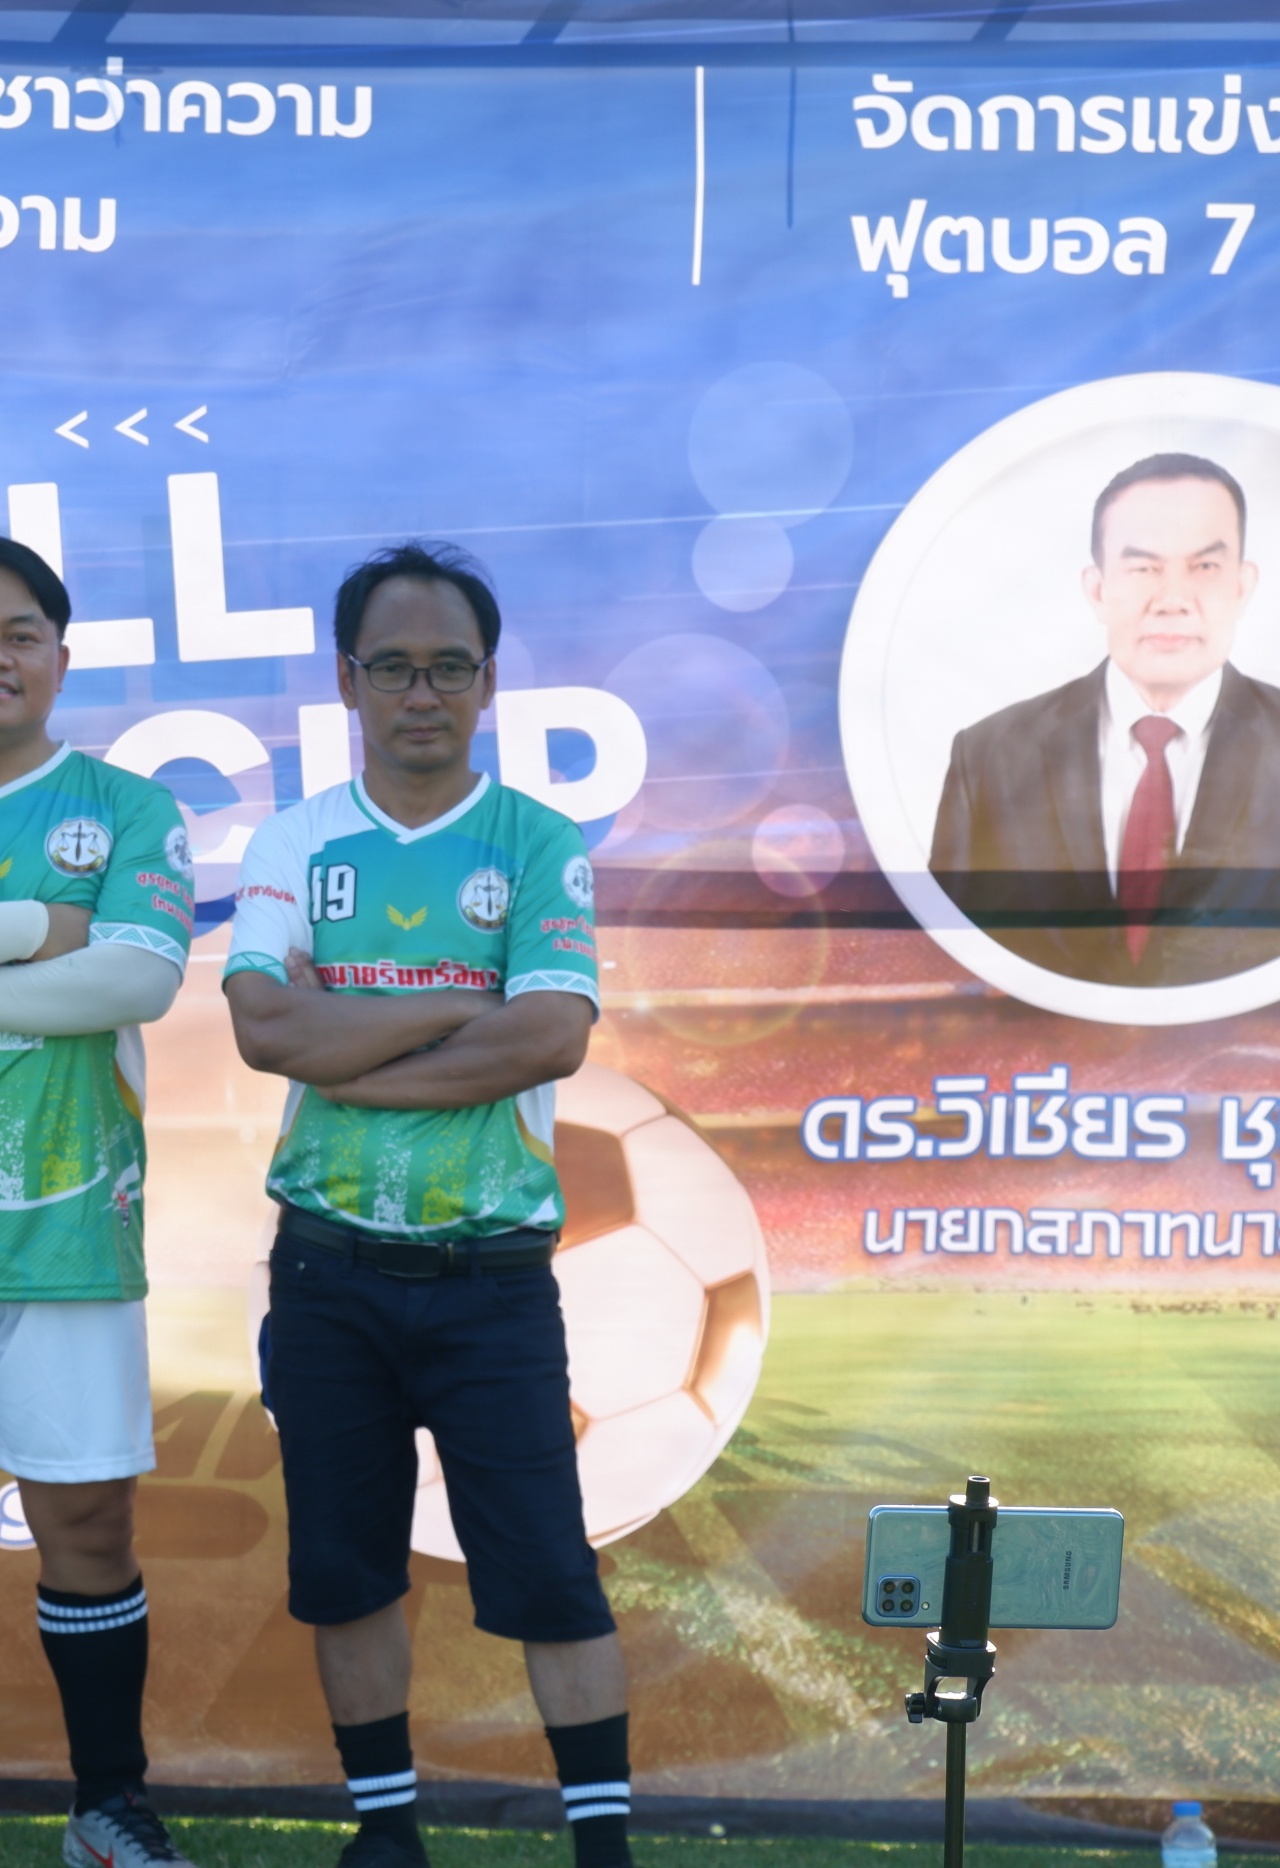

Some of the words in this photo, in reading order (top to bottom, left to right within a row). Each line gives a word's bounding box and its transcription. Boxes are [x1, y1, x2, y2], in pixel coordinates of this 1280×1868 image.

[850, 198, 1169, 299] ฟุตบอล
[1205, 202, 1256, 276] 7
[801, 1064, 1188, 1162] ดร.วิเชียร
[863, 1207, 1280, 1258] นายกสภาทนา
[1062, 1550, 1072, 1590] SAMSUNG
